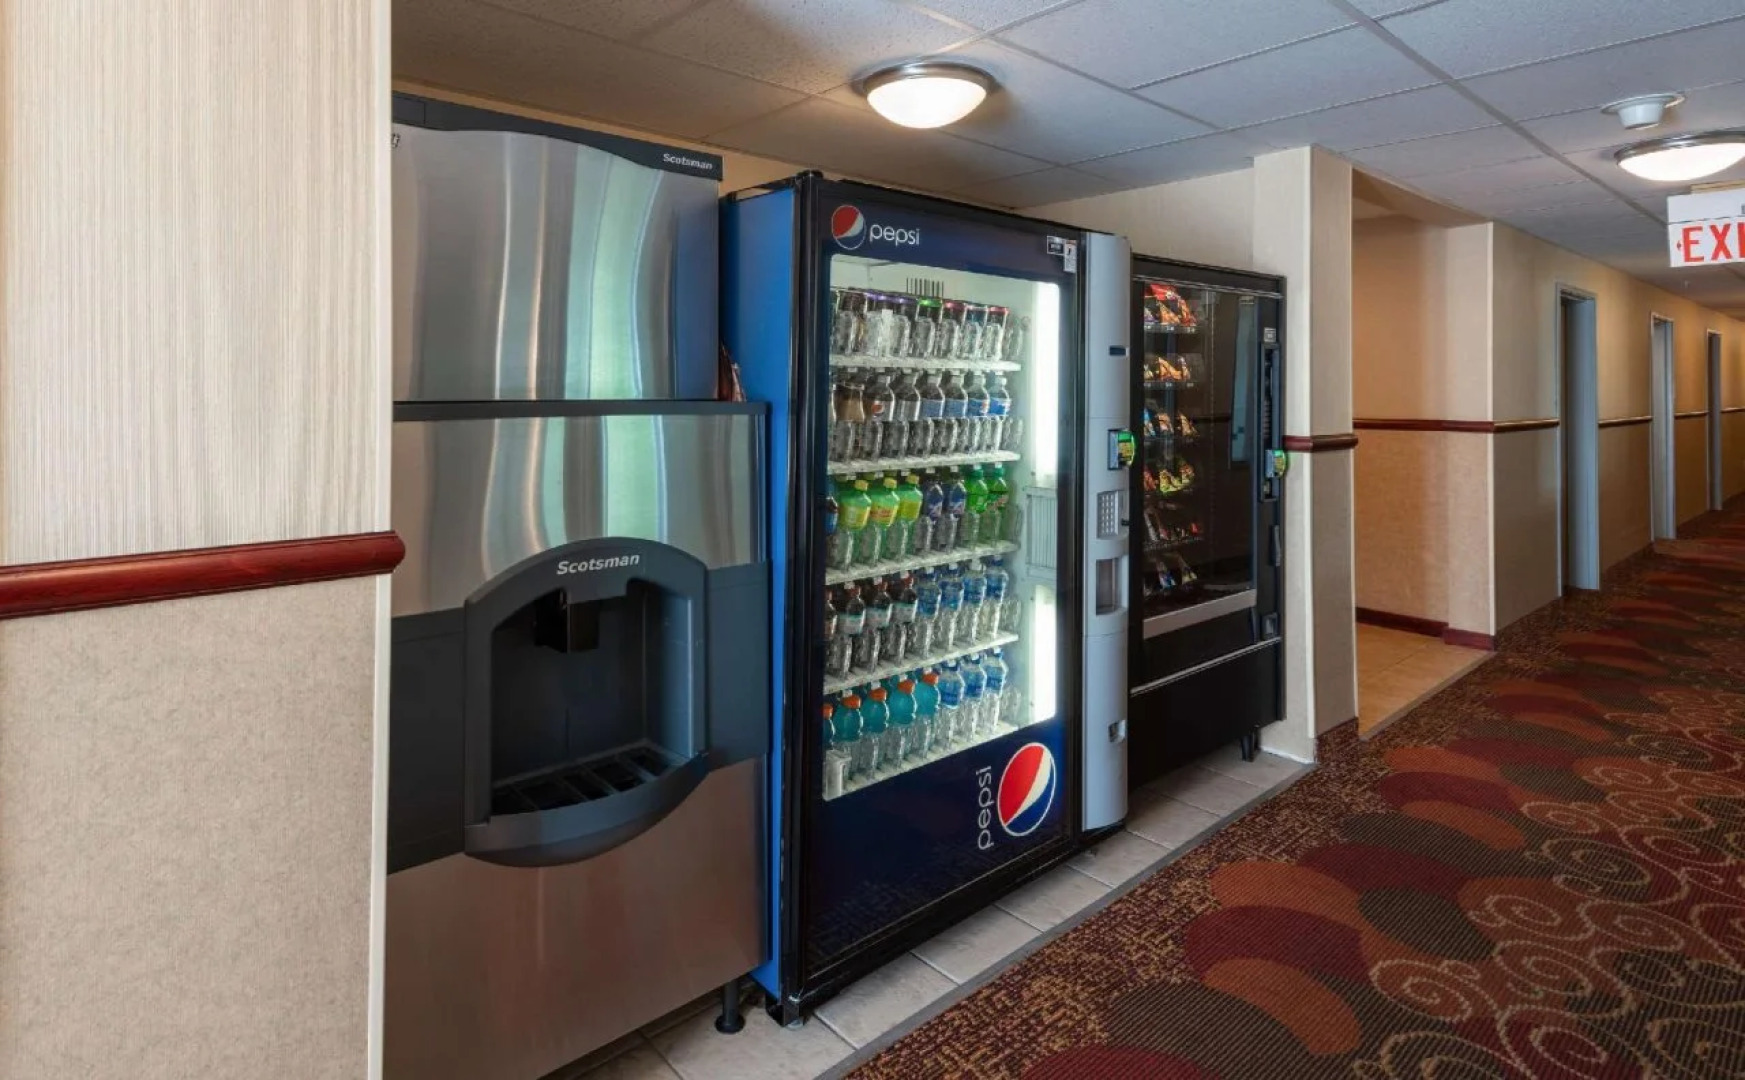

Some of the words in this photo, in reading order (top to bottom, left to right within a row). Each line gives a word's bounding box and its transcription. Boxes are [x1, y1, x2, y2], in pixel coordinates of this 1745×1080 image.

[663, 153, 713, 170] Scotsman
[869, 224, 920, 246] pepsi
[556, 554, 640, 575] Scotsman
[976, 766, 994, 850] pepsi
